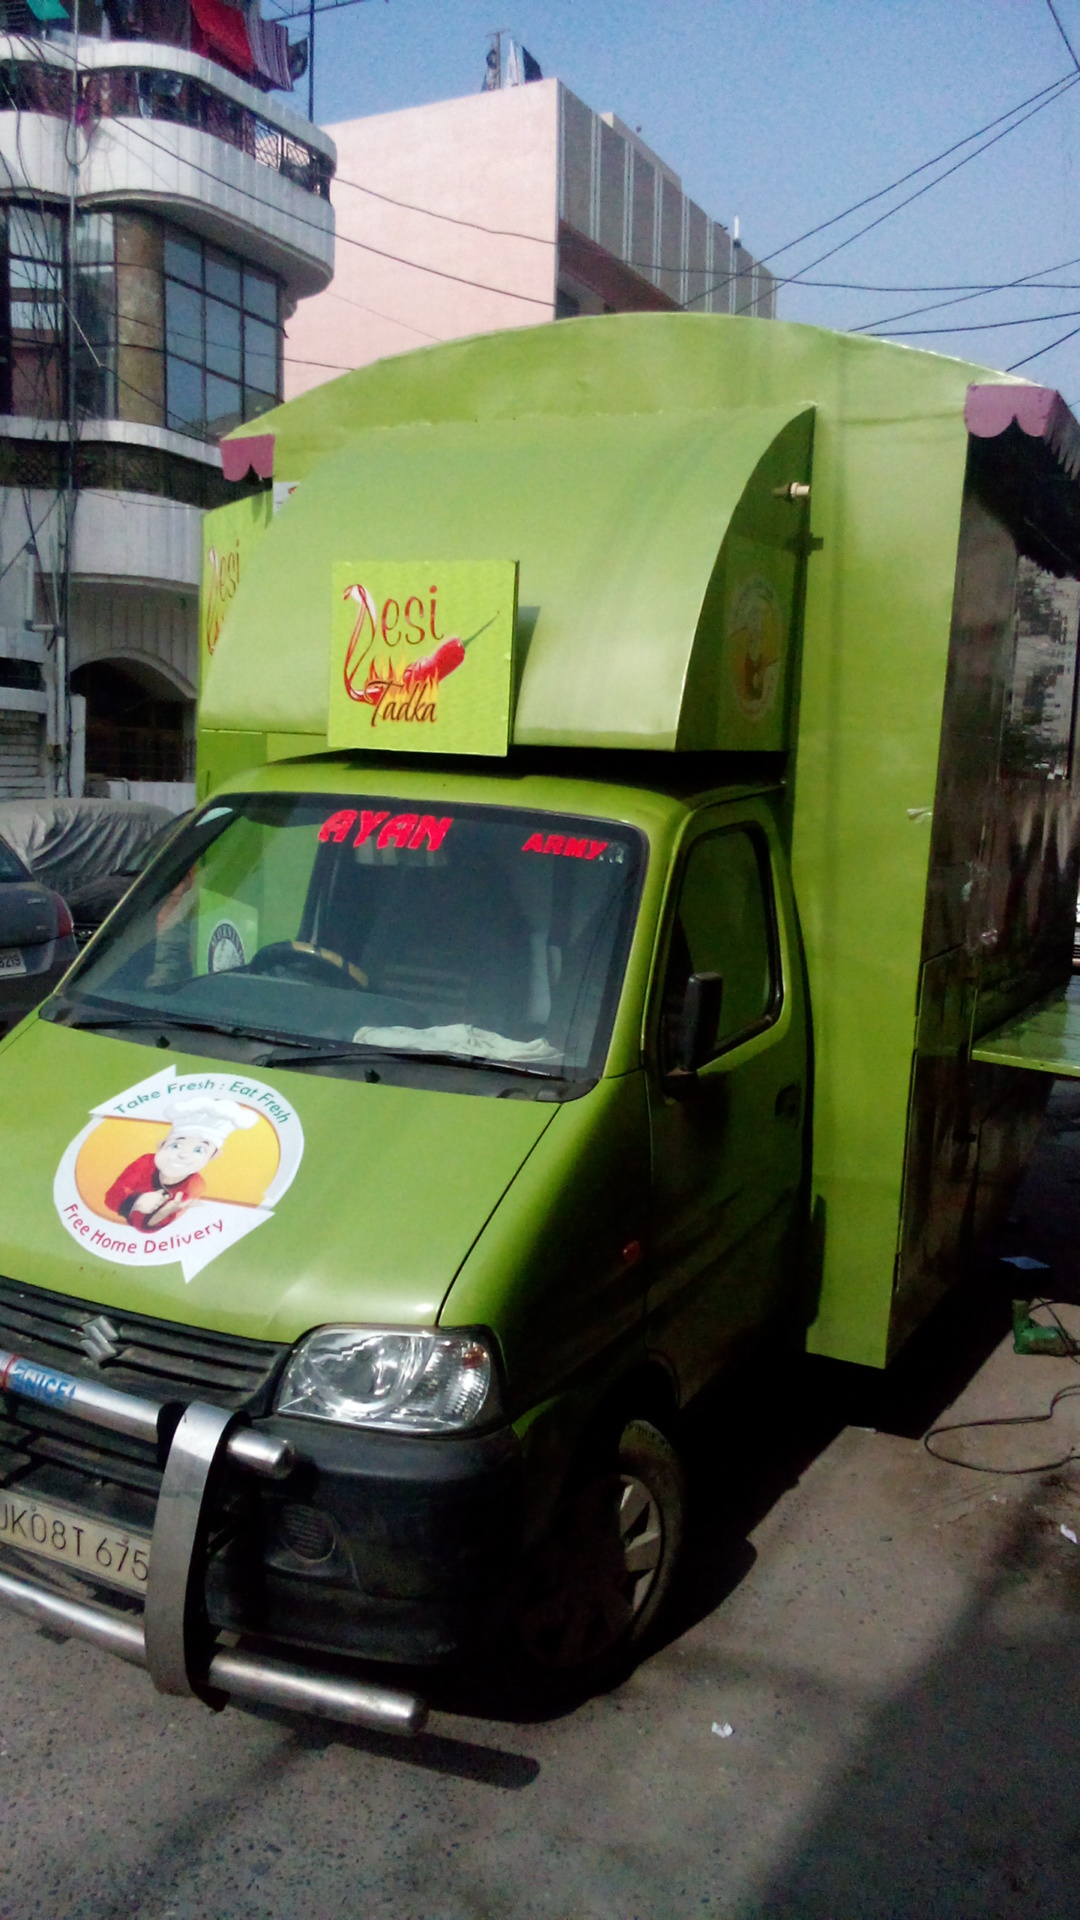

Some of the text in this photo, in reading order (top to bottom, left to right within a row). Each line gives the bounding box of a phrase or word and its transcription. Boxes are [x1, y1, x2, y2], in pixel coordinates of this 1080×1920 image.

[343, 583, 444, 707] Desi
[363, 679, 438, 728] Tadka
[317, 808, 454, 852] AYAN
[521, 832, 609, 861] ARMY
[113, 1090, 161, 1115] Take
[167, 1079, 215, 1095] Fresh
[228, 1081, 260, 1098] Eat
[257, 1091, 292, 1124] Fresh
[63, 1203, 224, 1254] Free Home Delivery
